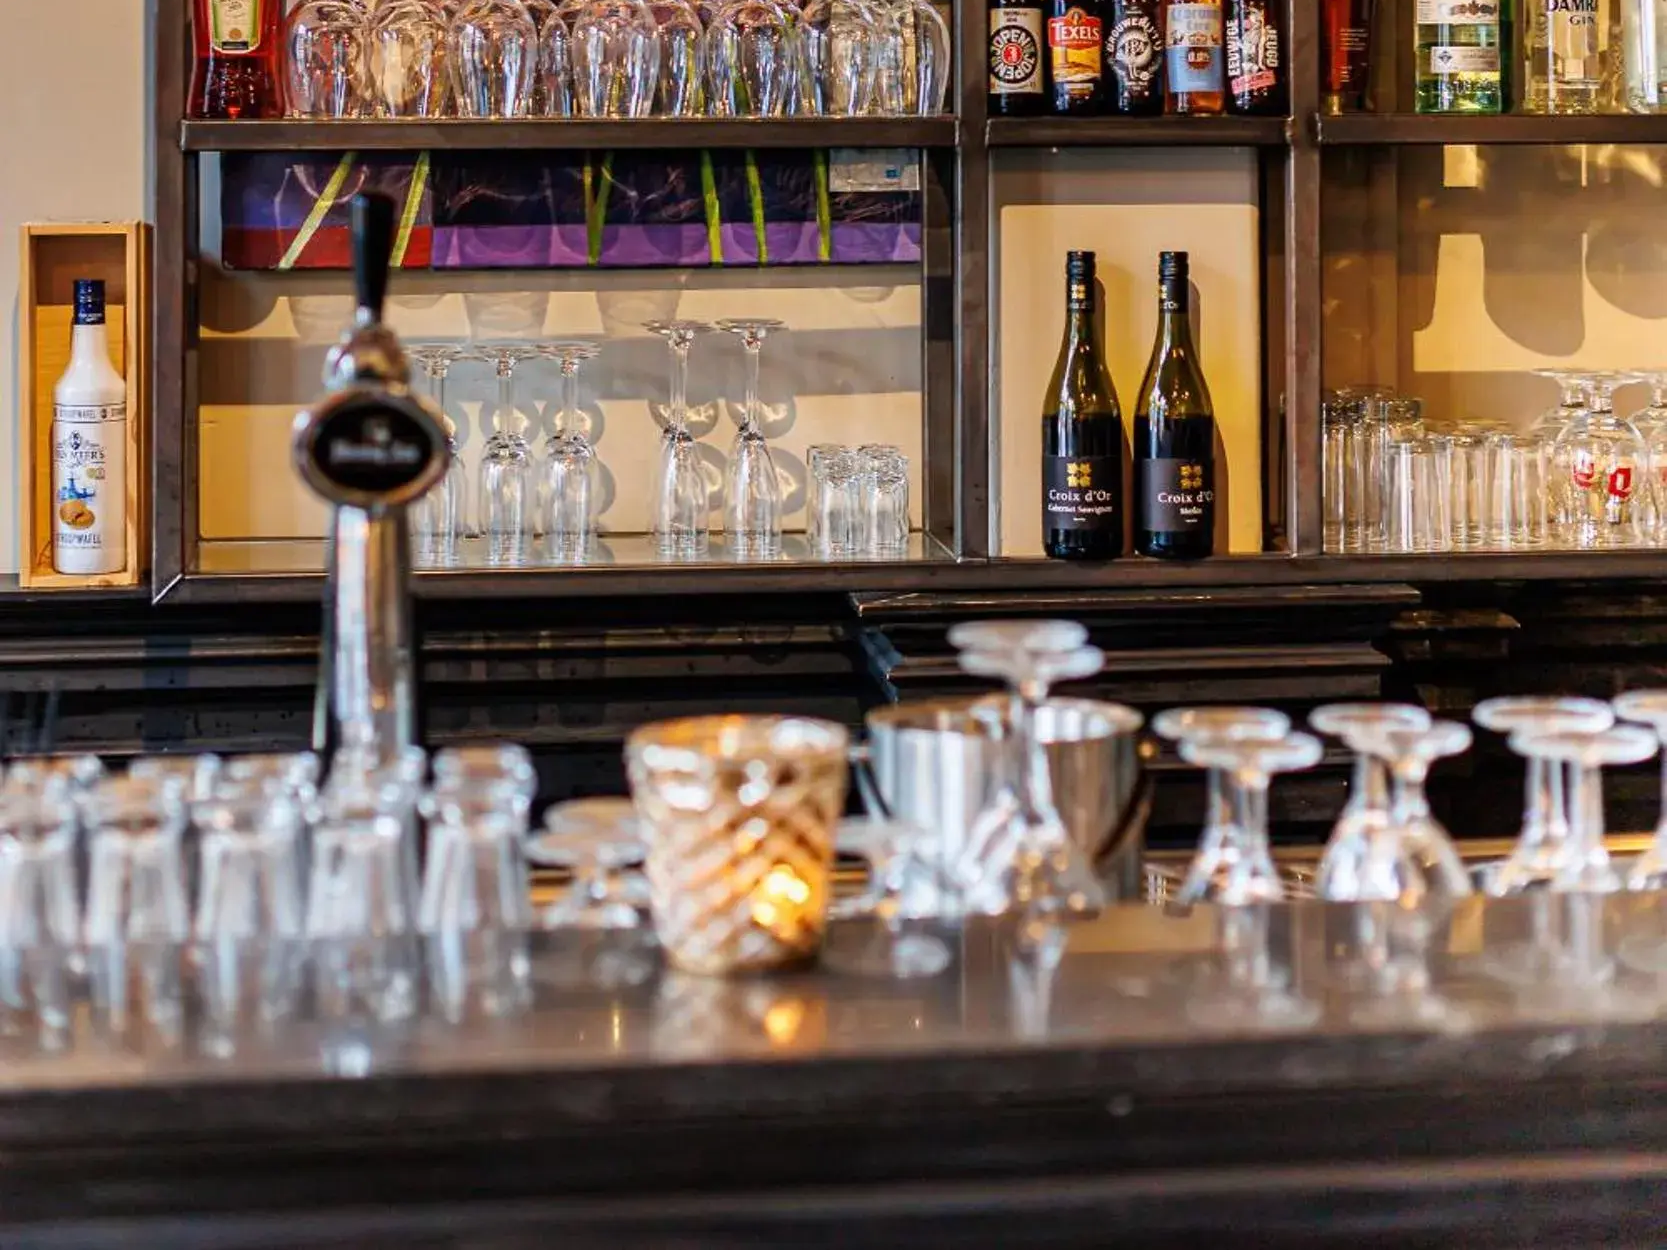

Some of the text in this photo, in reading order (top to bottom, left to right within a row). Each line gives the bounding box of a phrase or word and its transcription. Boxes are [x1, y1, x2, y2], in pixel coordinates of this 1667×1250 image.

[1051, 22, 1100, 41] TEXELS
[1049, 489, 1080, 502] Croix
[1157, 490, 1213, 504] Croix d'O
